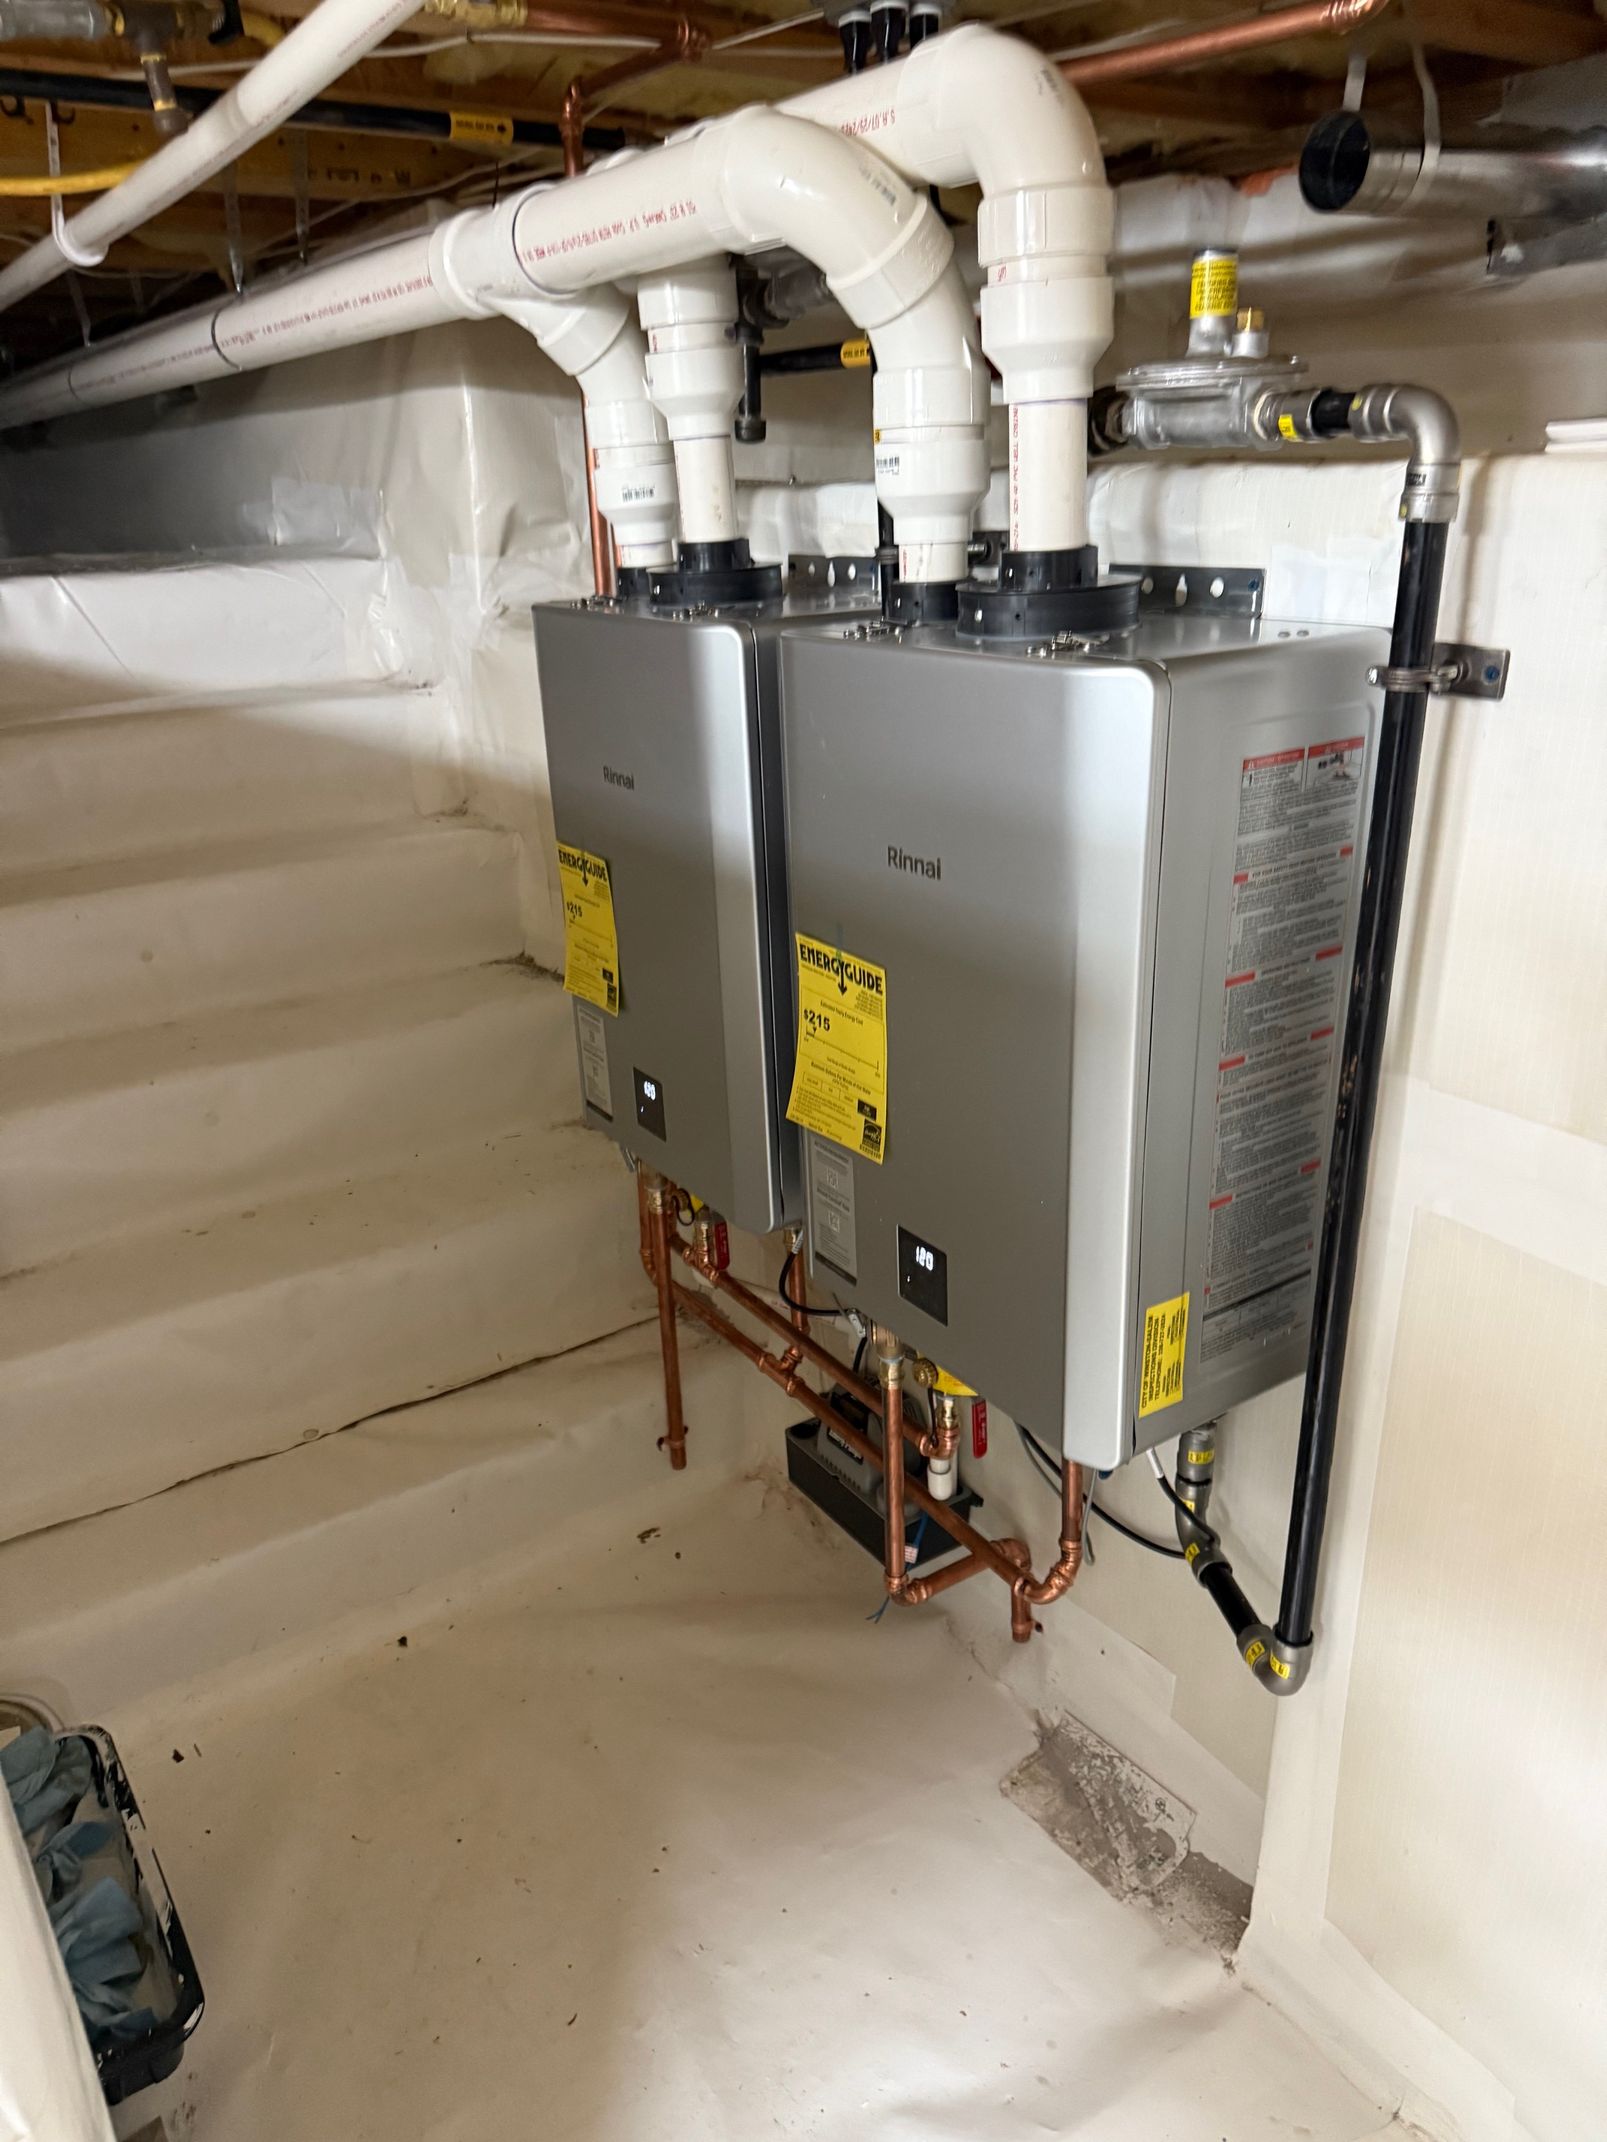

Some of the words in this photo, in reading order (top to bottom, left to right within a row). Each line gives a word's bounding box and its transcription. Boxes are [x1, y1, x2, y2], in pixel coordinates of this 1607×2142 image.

[603, 765, 635, 791] Rinnai
[887, 845, 942, 881] Rinnai
[799, 943, 883, 996] ENERGYGUIDE
[803, 1008, 831, 1032] $215
